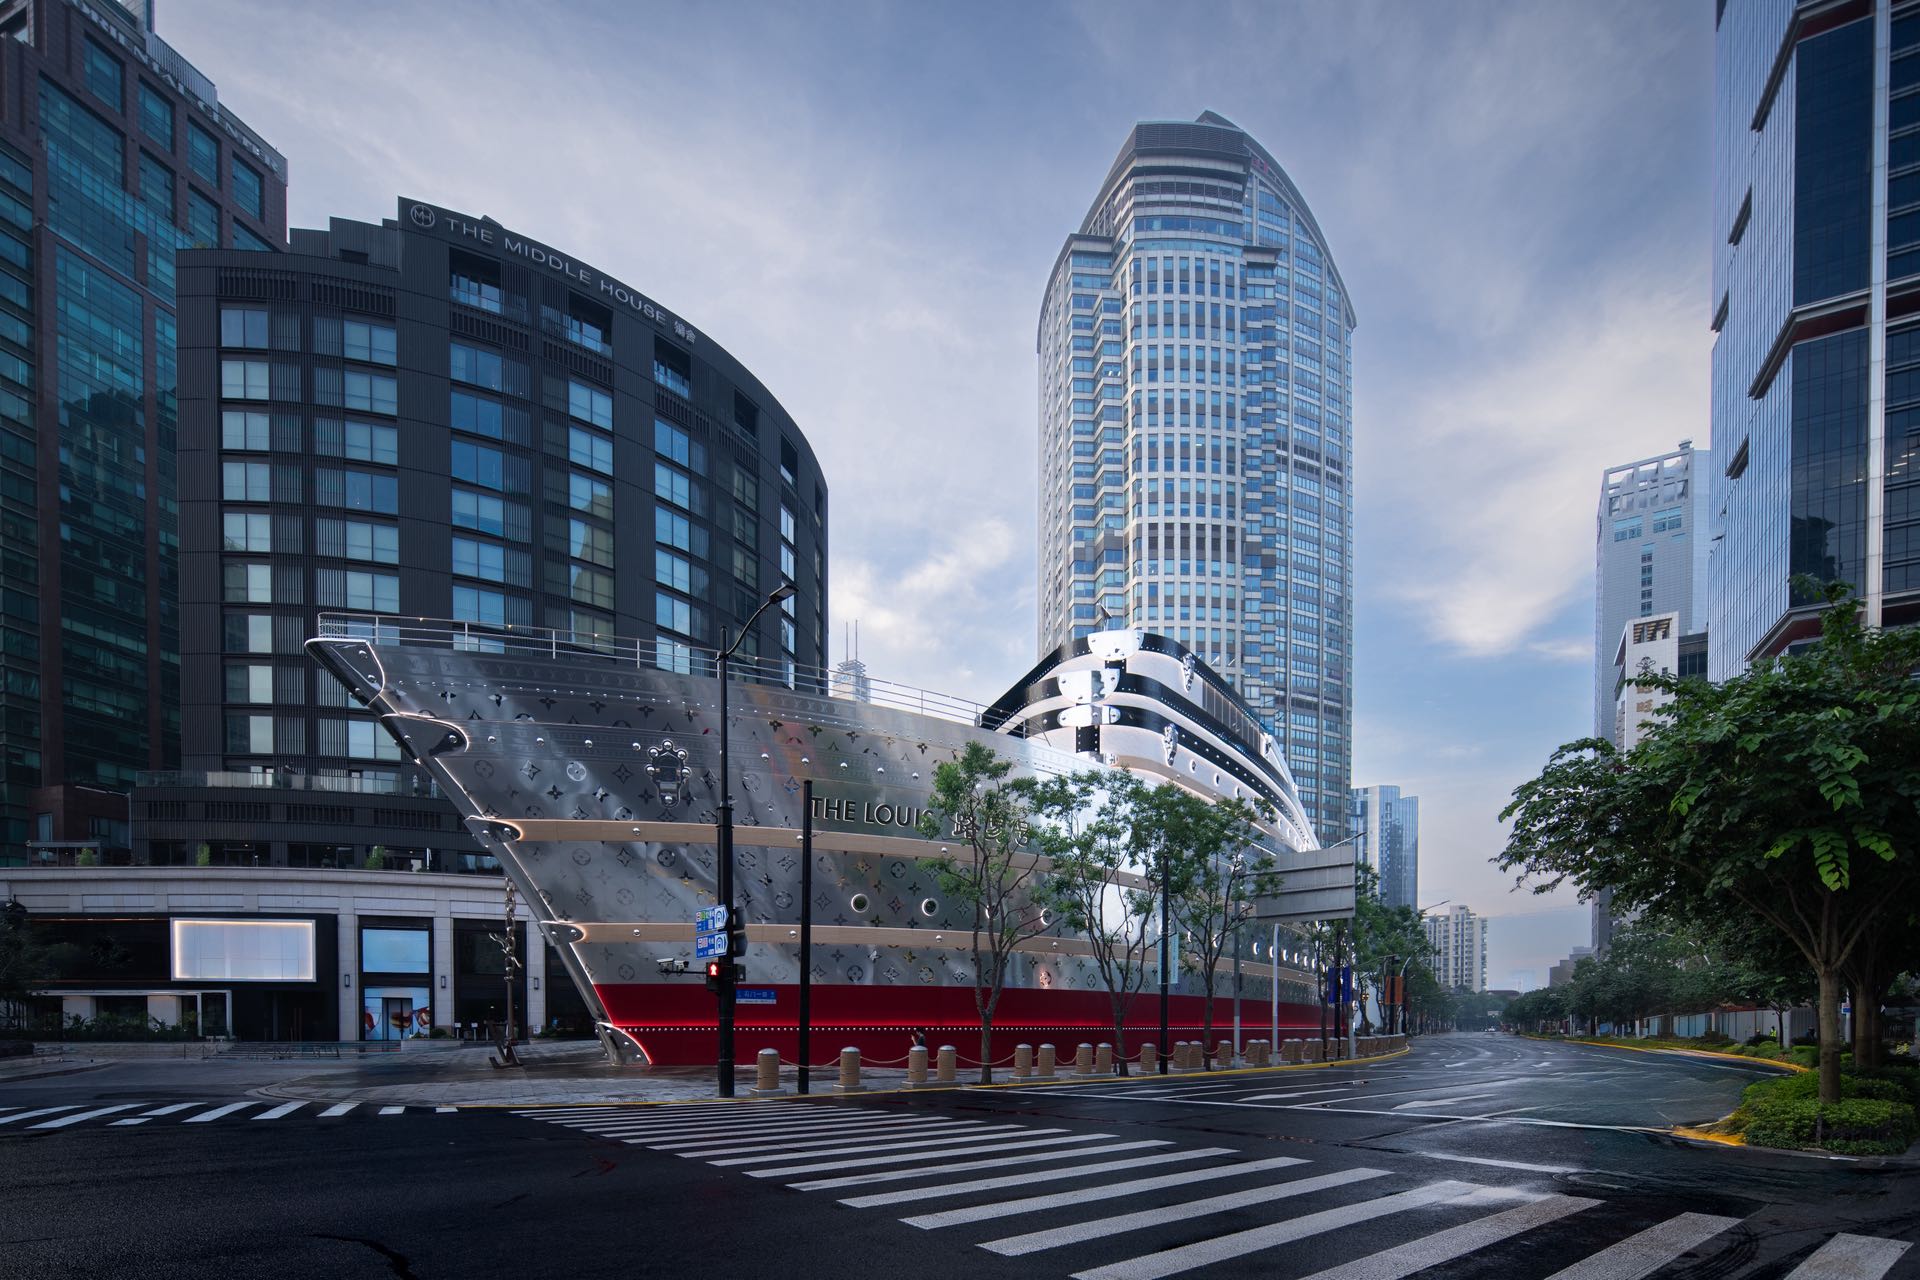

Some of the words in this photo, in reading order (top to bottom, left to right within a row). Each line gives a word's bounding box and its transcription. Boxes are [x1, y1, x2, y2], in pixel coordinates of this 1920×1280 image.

[445, 217, 494, 244] THE
[504, 237, 592, 285] MIDDLE
[600, 279, 667, 325] HOUSE
[811, 797, 856, 822] THE
